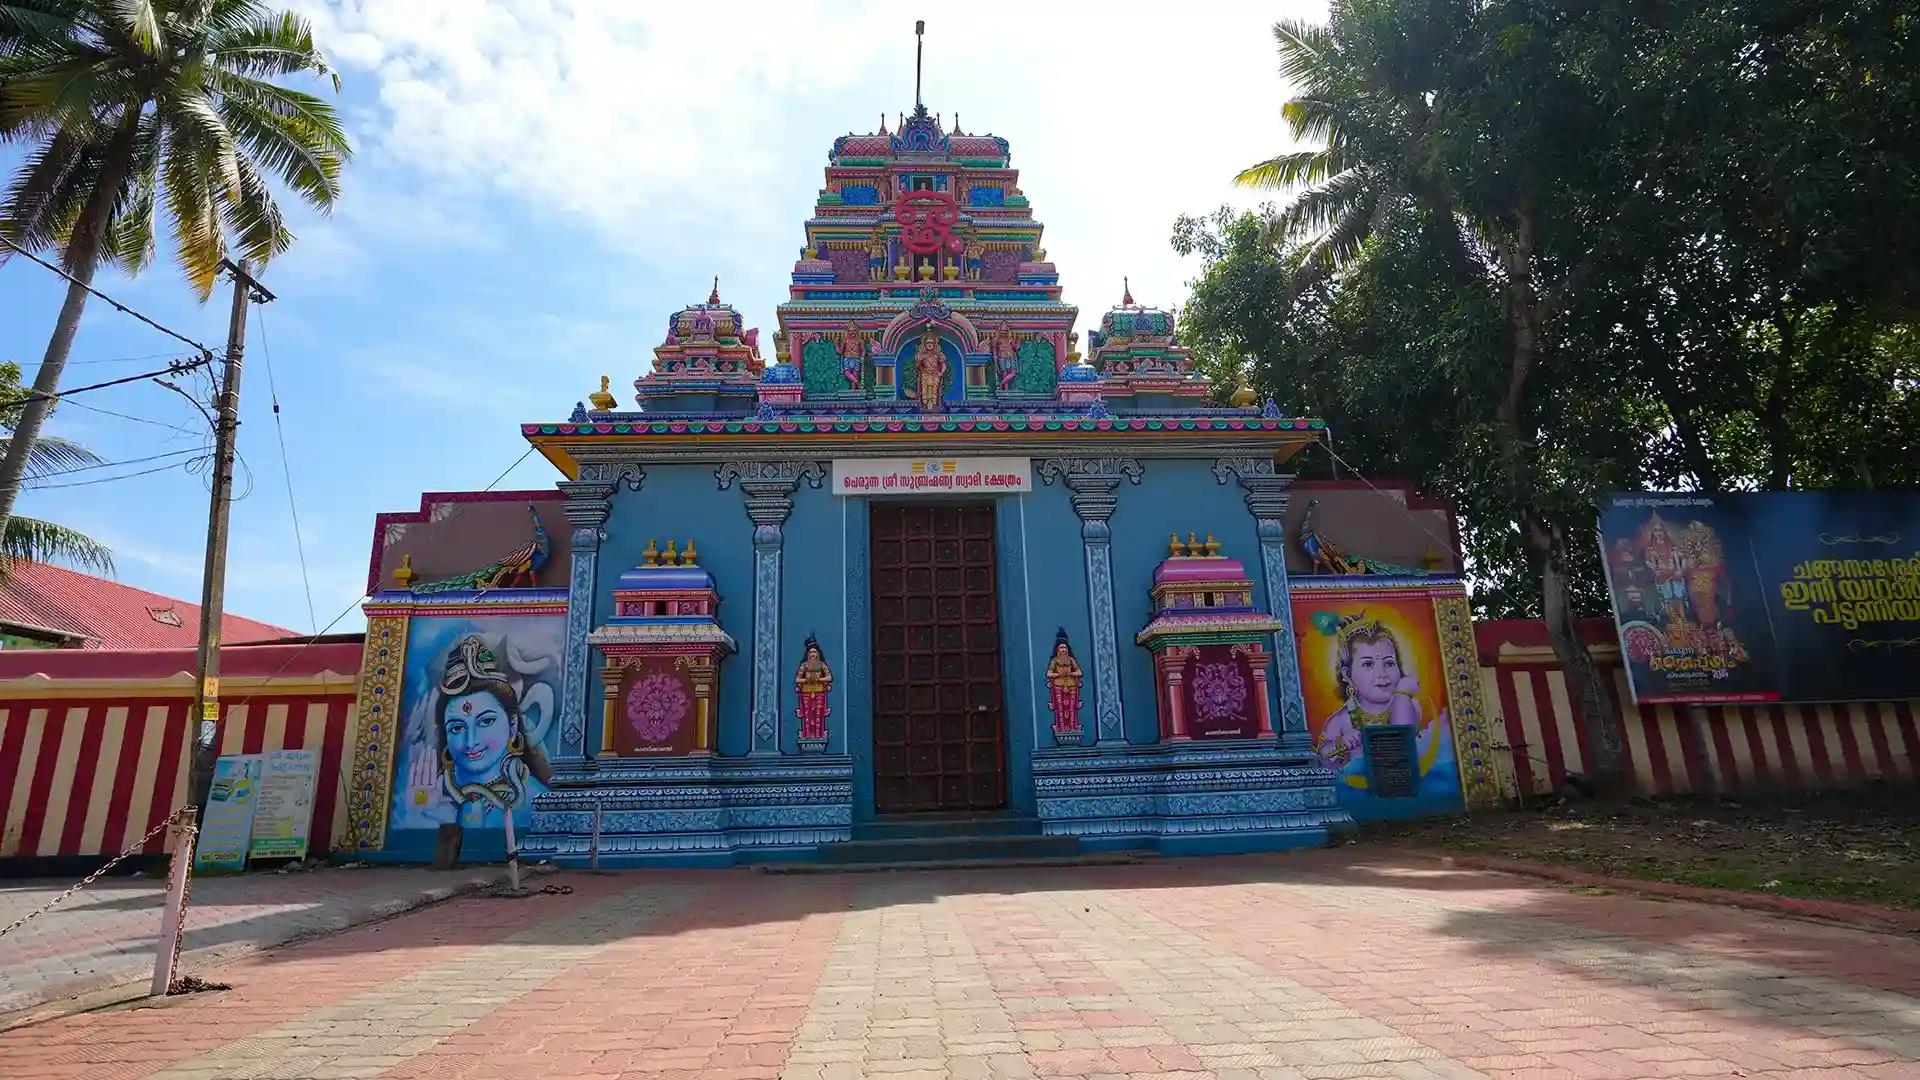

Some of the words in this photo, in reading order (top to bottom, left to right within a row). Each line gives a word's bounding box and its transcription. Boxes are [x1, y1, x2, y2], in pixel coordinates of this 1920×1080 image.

[844, 476, 880, 490] പെരുന്ന
[882, 473, 898, 490] ശ്രീ
[900, 474, 952, 490] സുബ്രഹ്മണ്യ
[955, 472, 982, 489] സ്വാമി
[984, 474, 1022, 488] ക്ഷേത്രം
[1780, 579, 1837, 610] ഇനി
